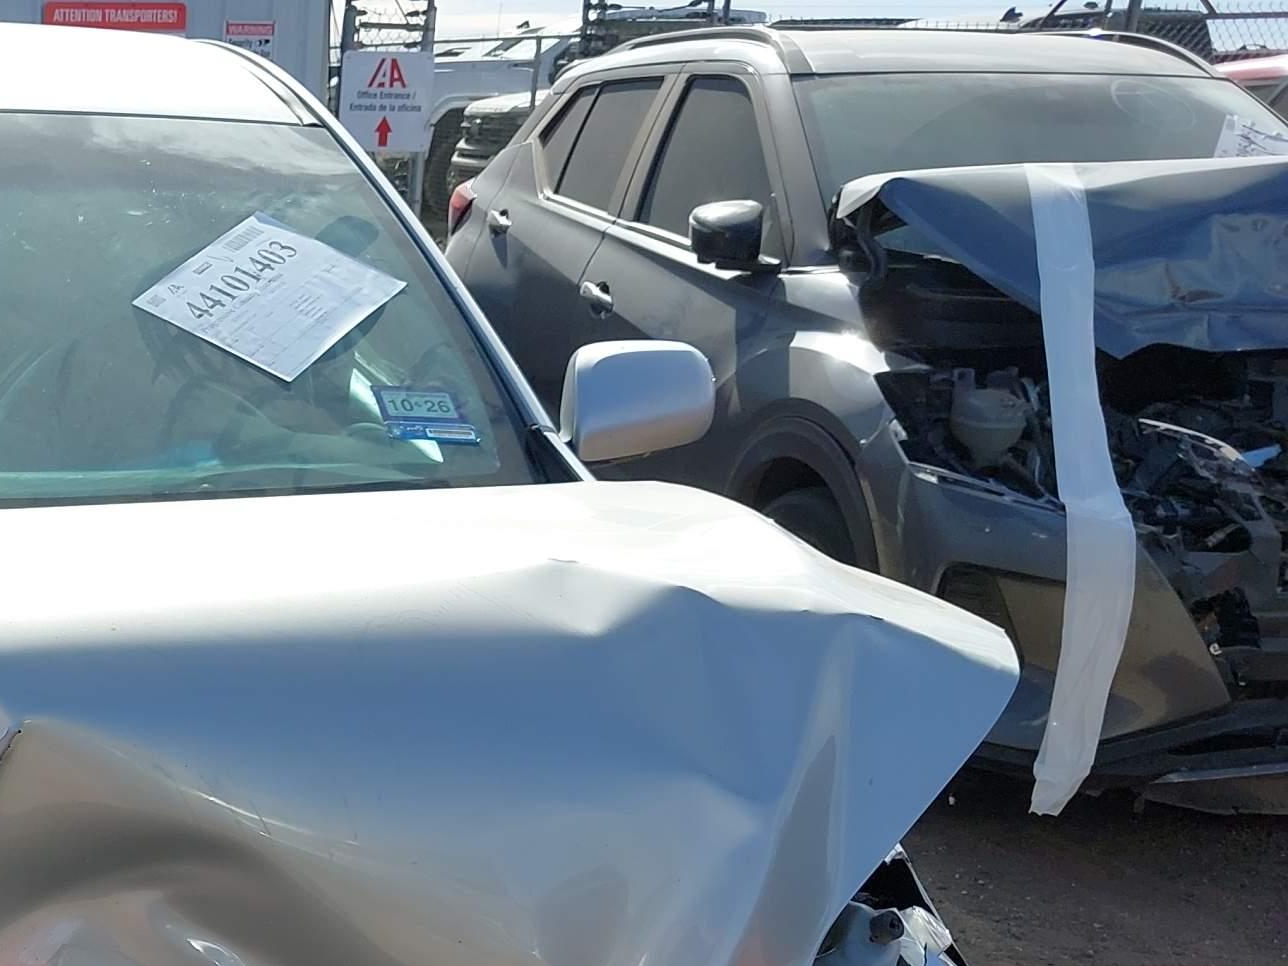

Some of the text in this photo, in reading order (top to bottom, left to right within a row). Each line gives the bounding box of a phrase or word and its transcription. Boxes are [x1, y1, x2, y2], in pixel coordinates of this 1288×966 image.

[53, 9, 178, 24] ATTENTION TRANSPORTERS!
[357, 90, 378, 99] Office
[379, 91, 411, 99] Entrance
[349, 103, 422, 112] Entrada de la oficina
[186, 240, 297, 320] 44101403
